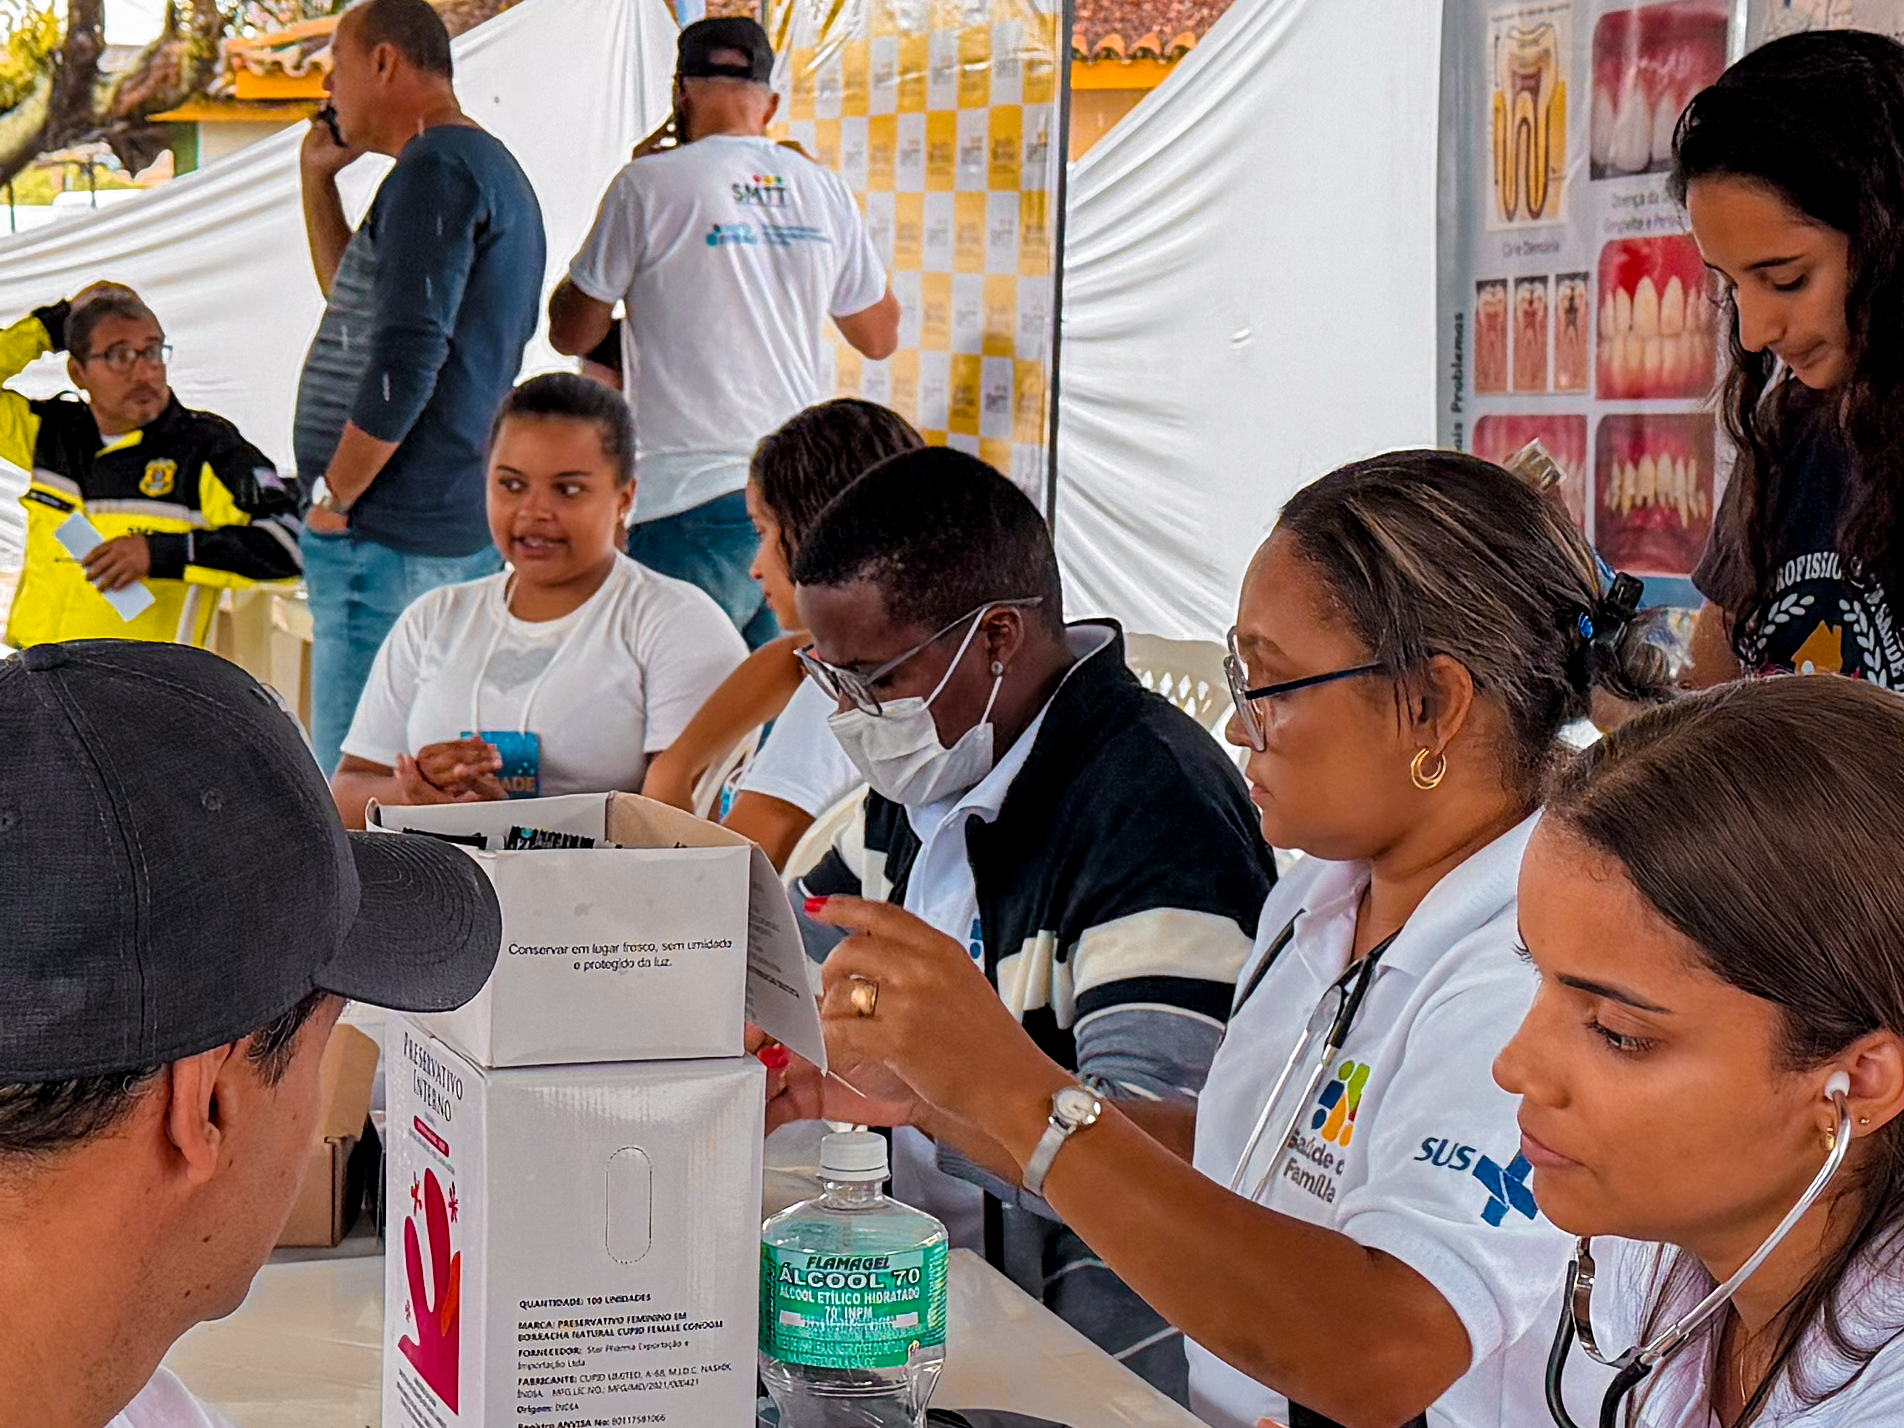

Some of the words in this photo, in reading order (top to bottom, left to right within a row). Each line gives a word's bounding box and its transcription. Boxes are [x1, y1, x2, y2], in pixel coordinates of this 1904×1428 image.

[502, 777, 537, 791] ADE
[509, 943, 568, 955] Conservar
[572, 944, 589, 954] em
[593, 942, 619, 957] lugar
[662, 941, 684, 950] sem
[404, 1031, 462, 1100] PRESERVATIVO
[1414, 1136, 1477, 1171] SUS
[806, 1255, 890, 1271] FLAMAGEL
[779, 1262, 885, 1290] ÁLCOOL
[892, 1267, 921, 1284] 70
[818, 1288, 860, 1305] ETÍLICO
[865, 1286, 920, 1304] HIDRATADO
